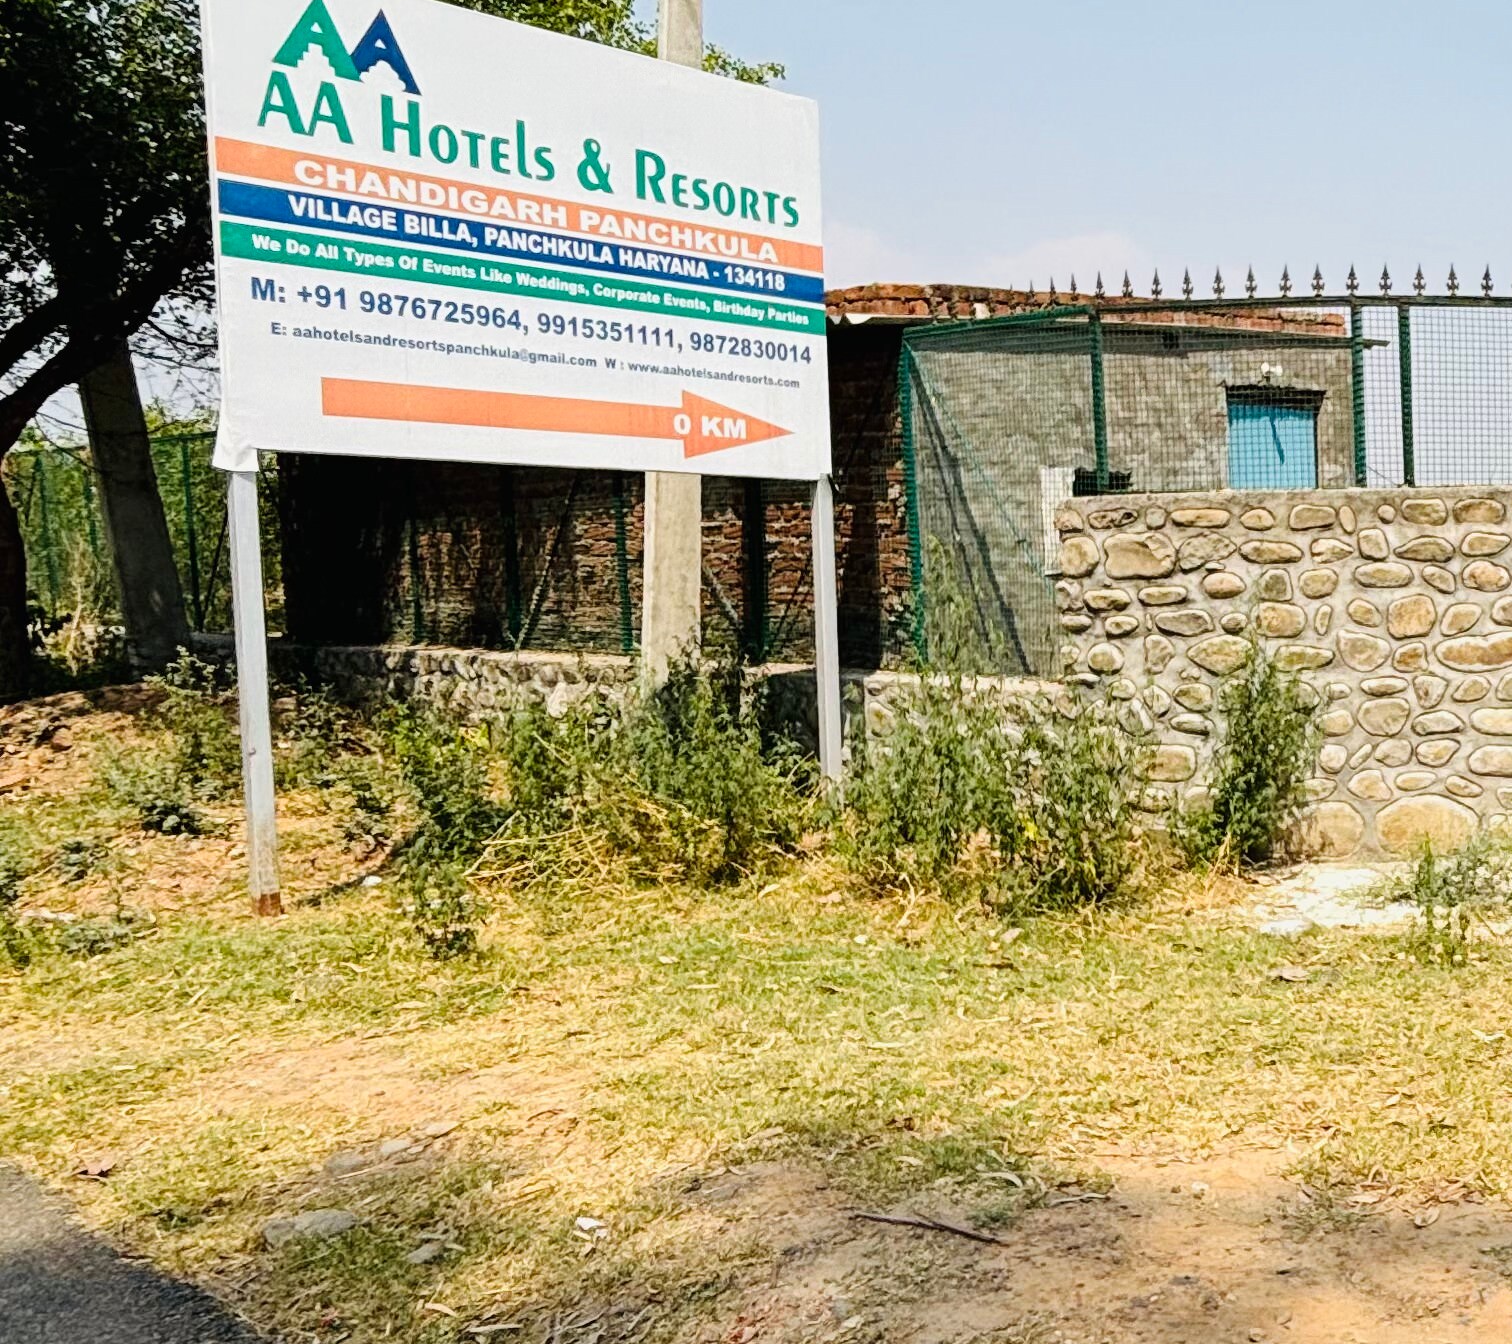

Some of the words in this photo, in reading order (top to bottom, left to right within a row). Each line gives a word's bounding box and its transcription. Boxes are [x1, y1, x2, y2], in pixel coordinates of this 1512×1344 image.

[257, 69, 355, 145] AA
[576, 138, 615, 195] &
[287, 194, 398, 232] VILLAGE
[403, 212, 479, 248] BILLA,
[484, 226, 615, 265] PANCHKULA
[618, 247, 710, 280] HARYANA
[713, 270, 721, 278] -
[723, 265, 786, 292] 134118
[293, 159, 568, 229] CHANDIGARH
[579, 209, 779, 264] PANCHKULA
[251, 233, 282, 252] We
[286, 238, 311, 257] Do
[315, 243, 339, 261] All
[343, 247, 395, 268] Types
[399, 254, 419, 271] Of
[422, 258, 477, 280] Events
[480, 266, 513, 284] Like
[515, 271, 590, 297] Weddings,
[593, 282, 661, 305] Corporate
[663, 292, 711, 314] Events,
[713, 299, 766, 322] Birthday
[768, 306, 810, 326] Parties
[251, 276, 287, 304] M:
[297, 284, 348, 311] +91
[359, 290, 529, 336] 9876725964,
[537, 312, 683, 353] 9915351111,
[689, 331, 812, 365] 9872830014
[270, 321, 288, 337] E:
[604, 357, 617, 370] W
[627, 361, 801, 389] www.aahotelsandresorts.com
[673, 413, 692, 436] 0
[701, 414, 747, 440] KM
